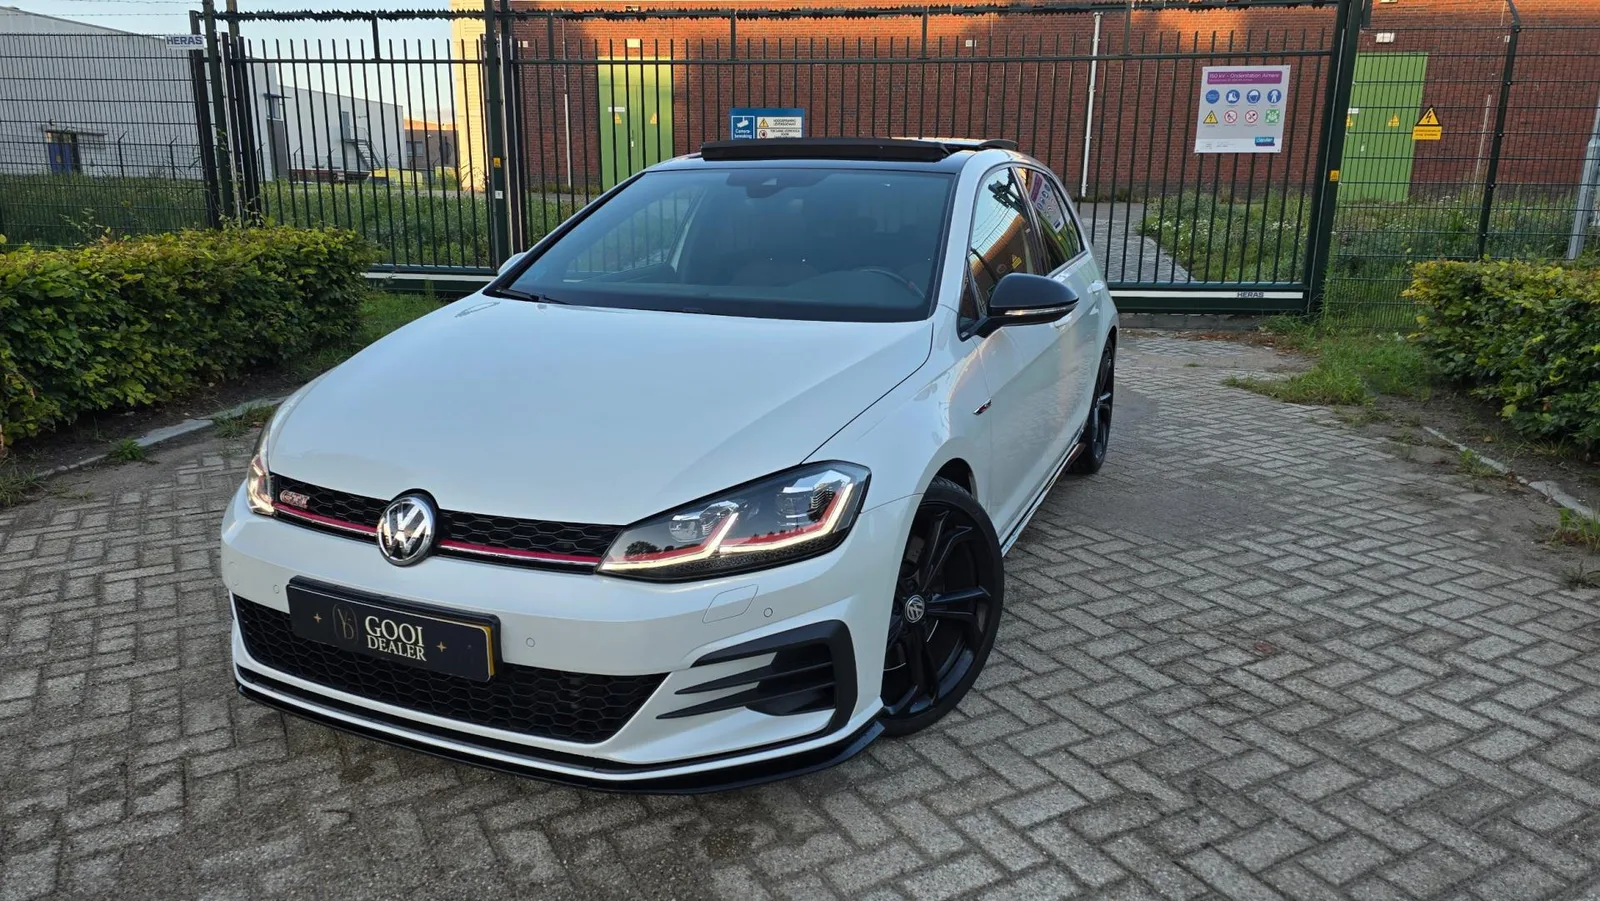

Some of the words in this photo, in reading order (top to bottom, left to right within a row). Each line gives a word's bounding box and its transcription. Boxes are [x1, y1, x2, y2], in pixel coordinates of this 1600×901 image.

[166, 36, 203, 45] HERAS
[279, 489, 310, 509] GTI
[365, 615, 424, 647] GOOI
[366, 634, 427, 662] DEALER
